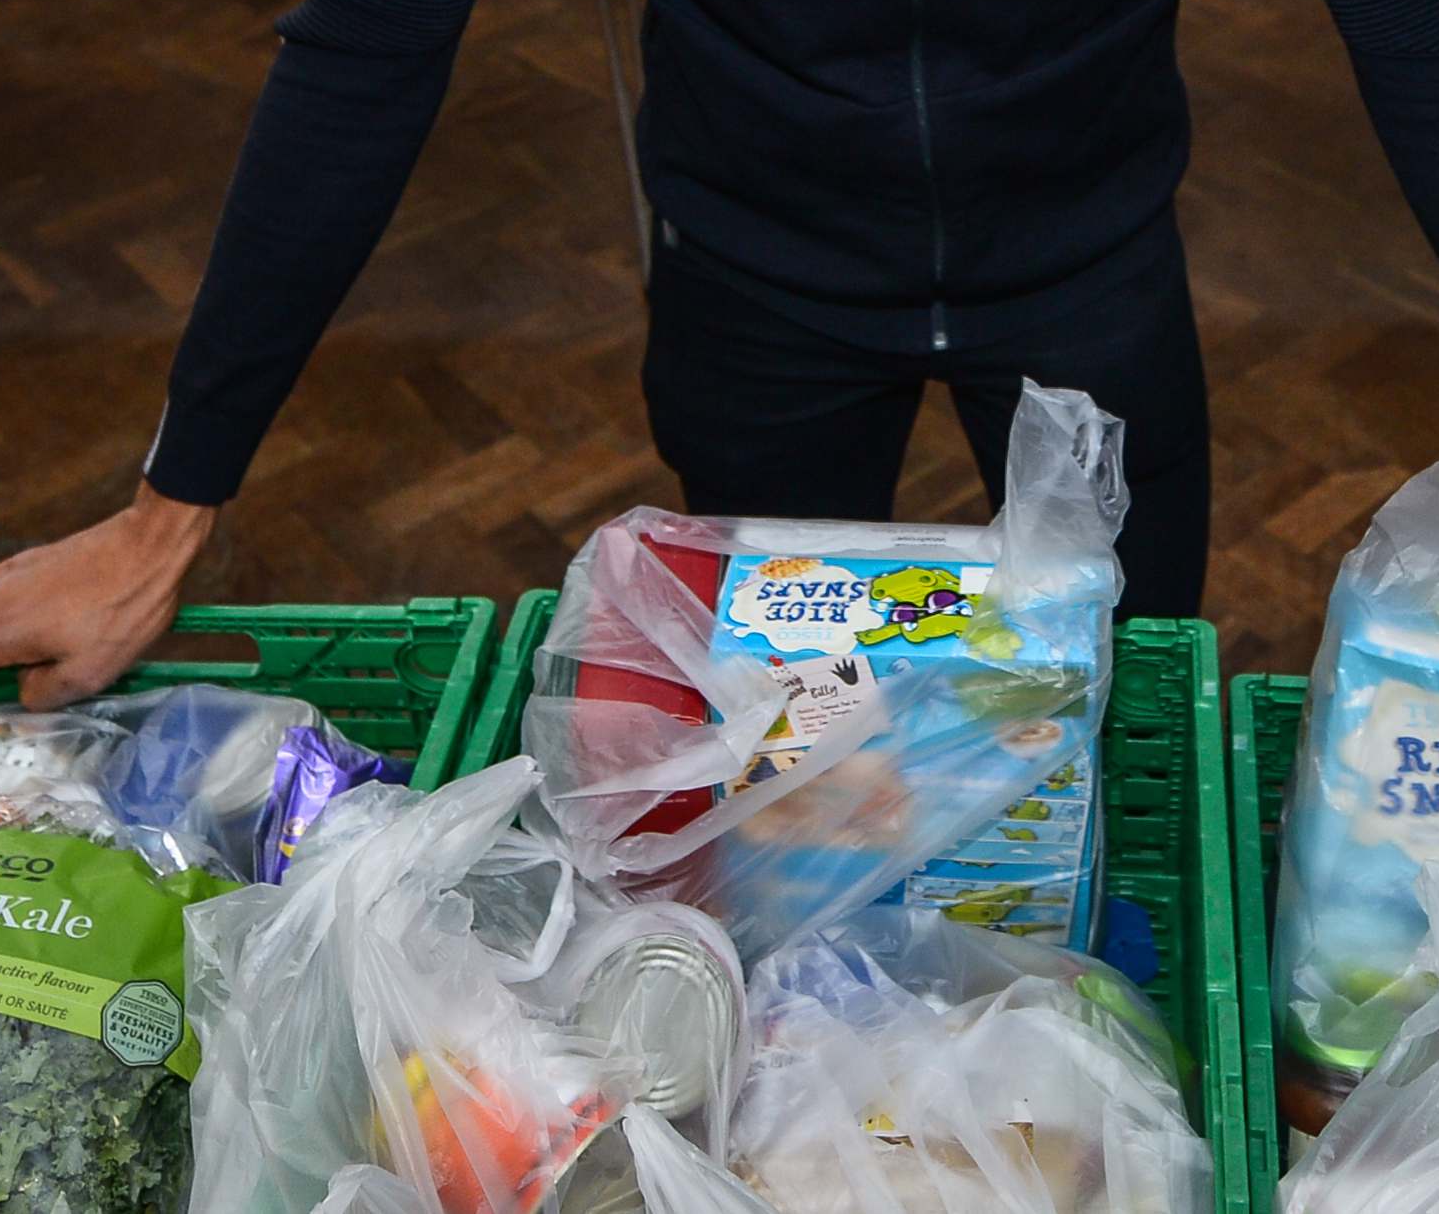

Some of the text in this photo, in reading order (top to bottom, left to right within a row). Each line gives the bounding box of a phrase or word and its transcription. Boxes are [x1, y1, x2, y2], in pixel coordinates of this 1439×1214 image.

[757, 580, 866, 601] SNAPS
[766, 601, 850, 623] RICE
[37, 969, 95, 996] flavour
[4, 994, 25, 1009] OR
[111, 1010, 175, 1041] FRESHNESS
[120, 1026, 168, 1048] QUALITY
